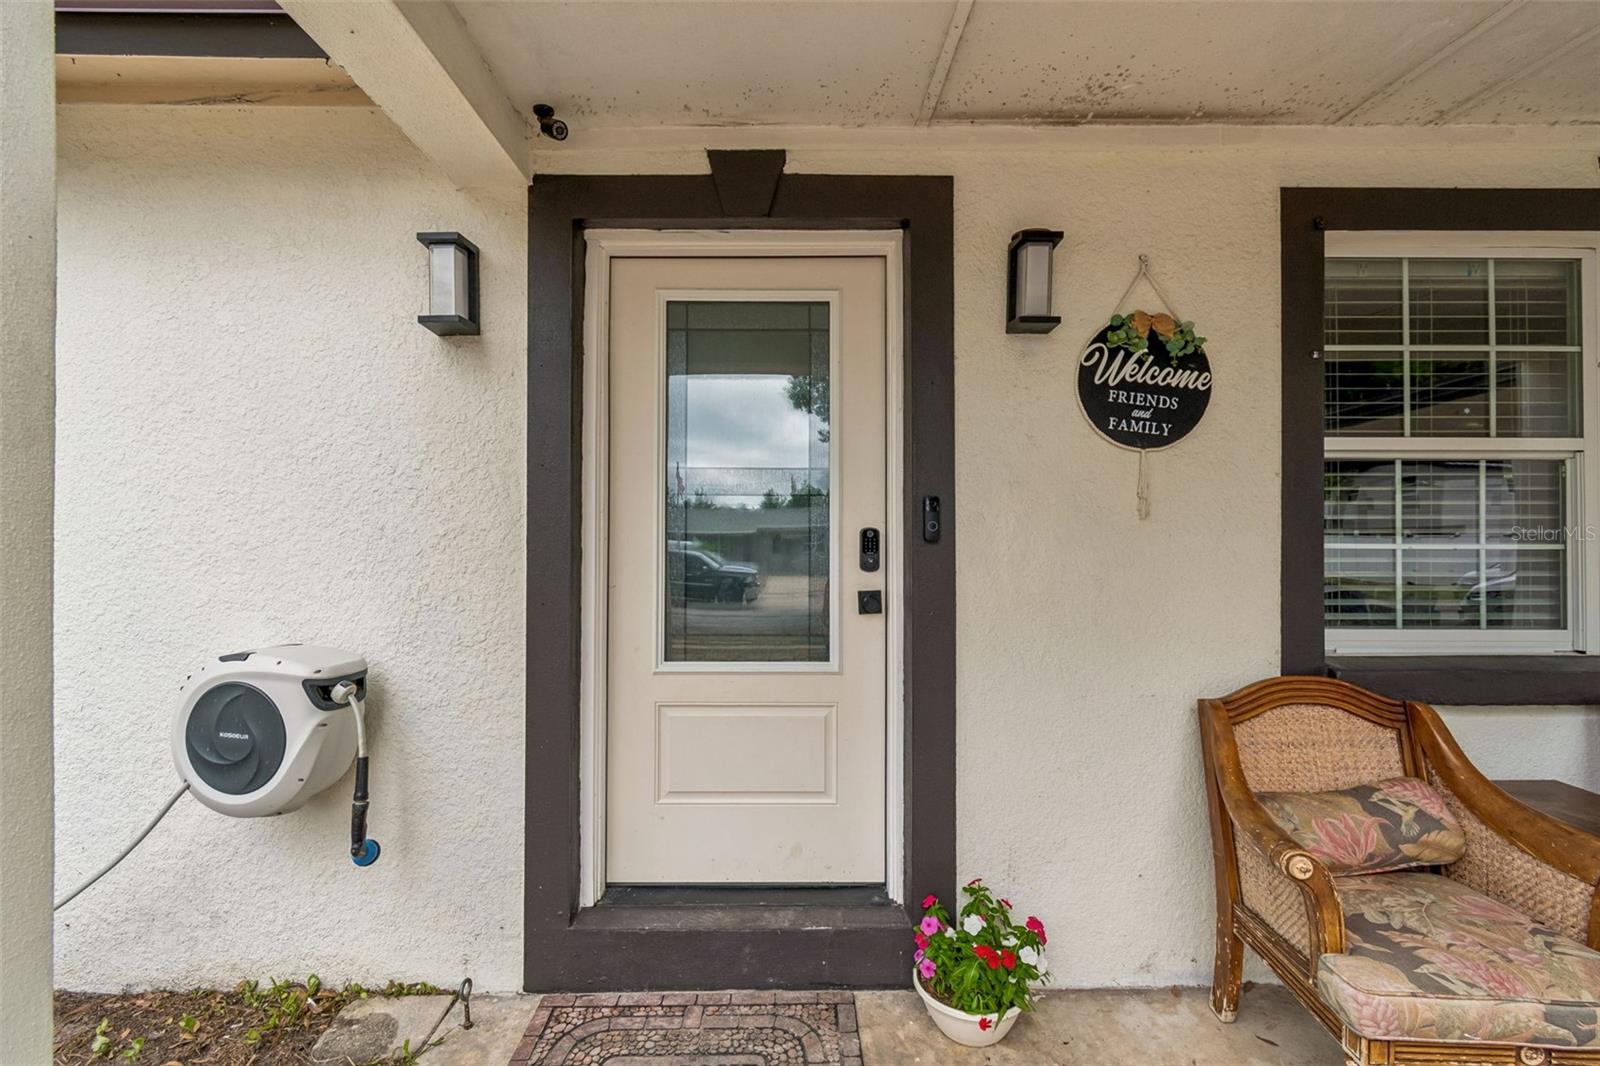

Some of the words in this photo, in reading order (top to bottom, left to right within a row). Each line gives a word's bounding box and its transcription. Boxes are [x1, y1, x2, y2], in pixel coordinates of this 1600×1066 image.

[1081, 343, 1212, 390] Welcome
[1108, 389, 1179, 410] FRIENDS
[1131, 408, 1154, 419] and
[1108, 417, 1173, 436] FAMILY
